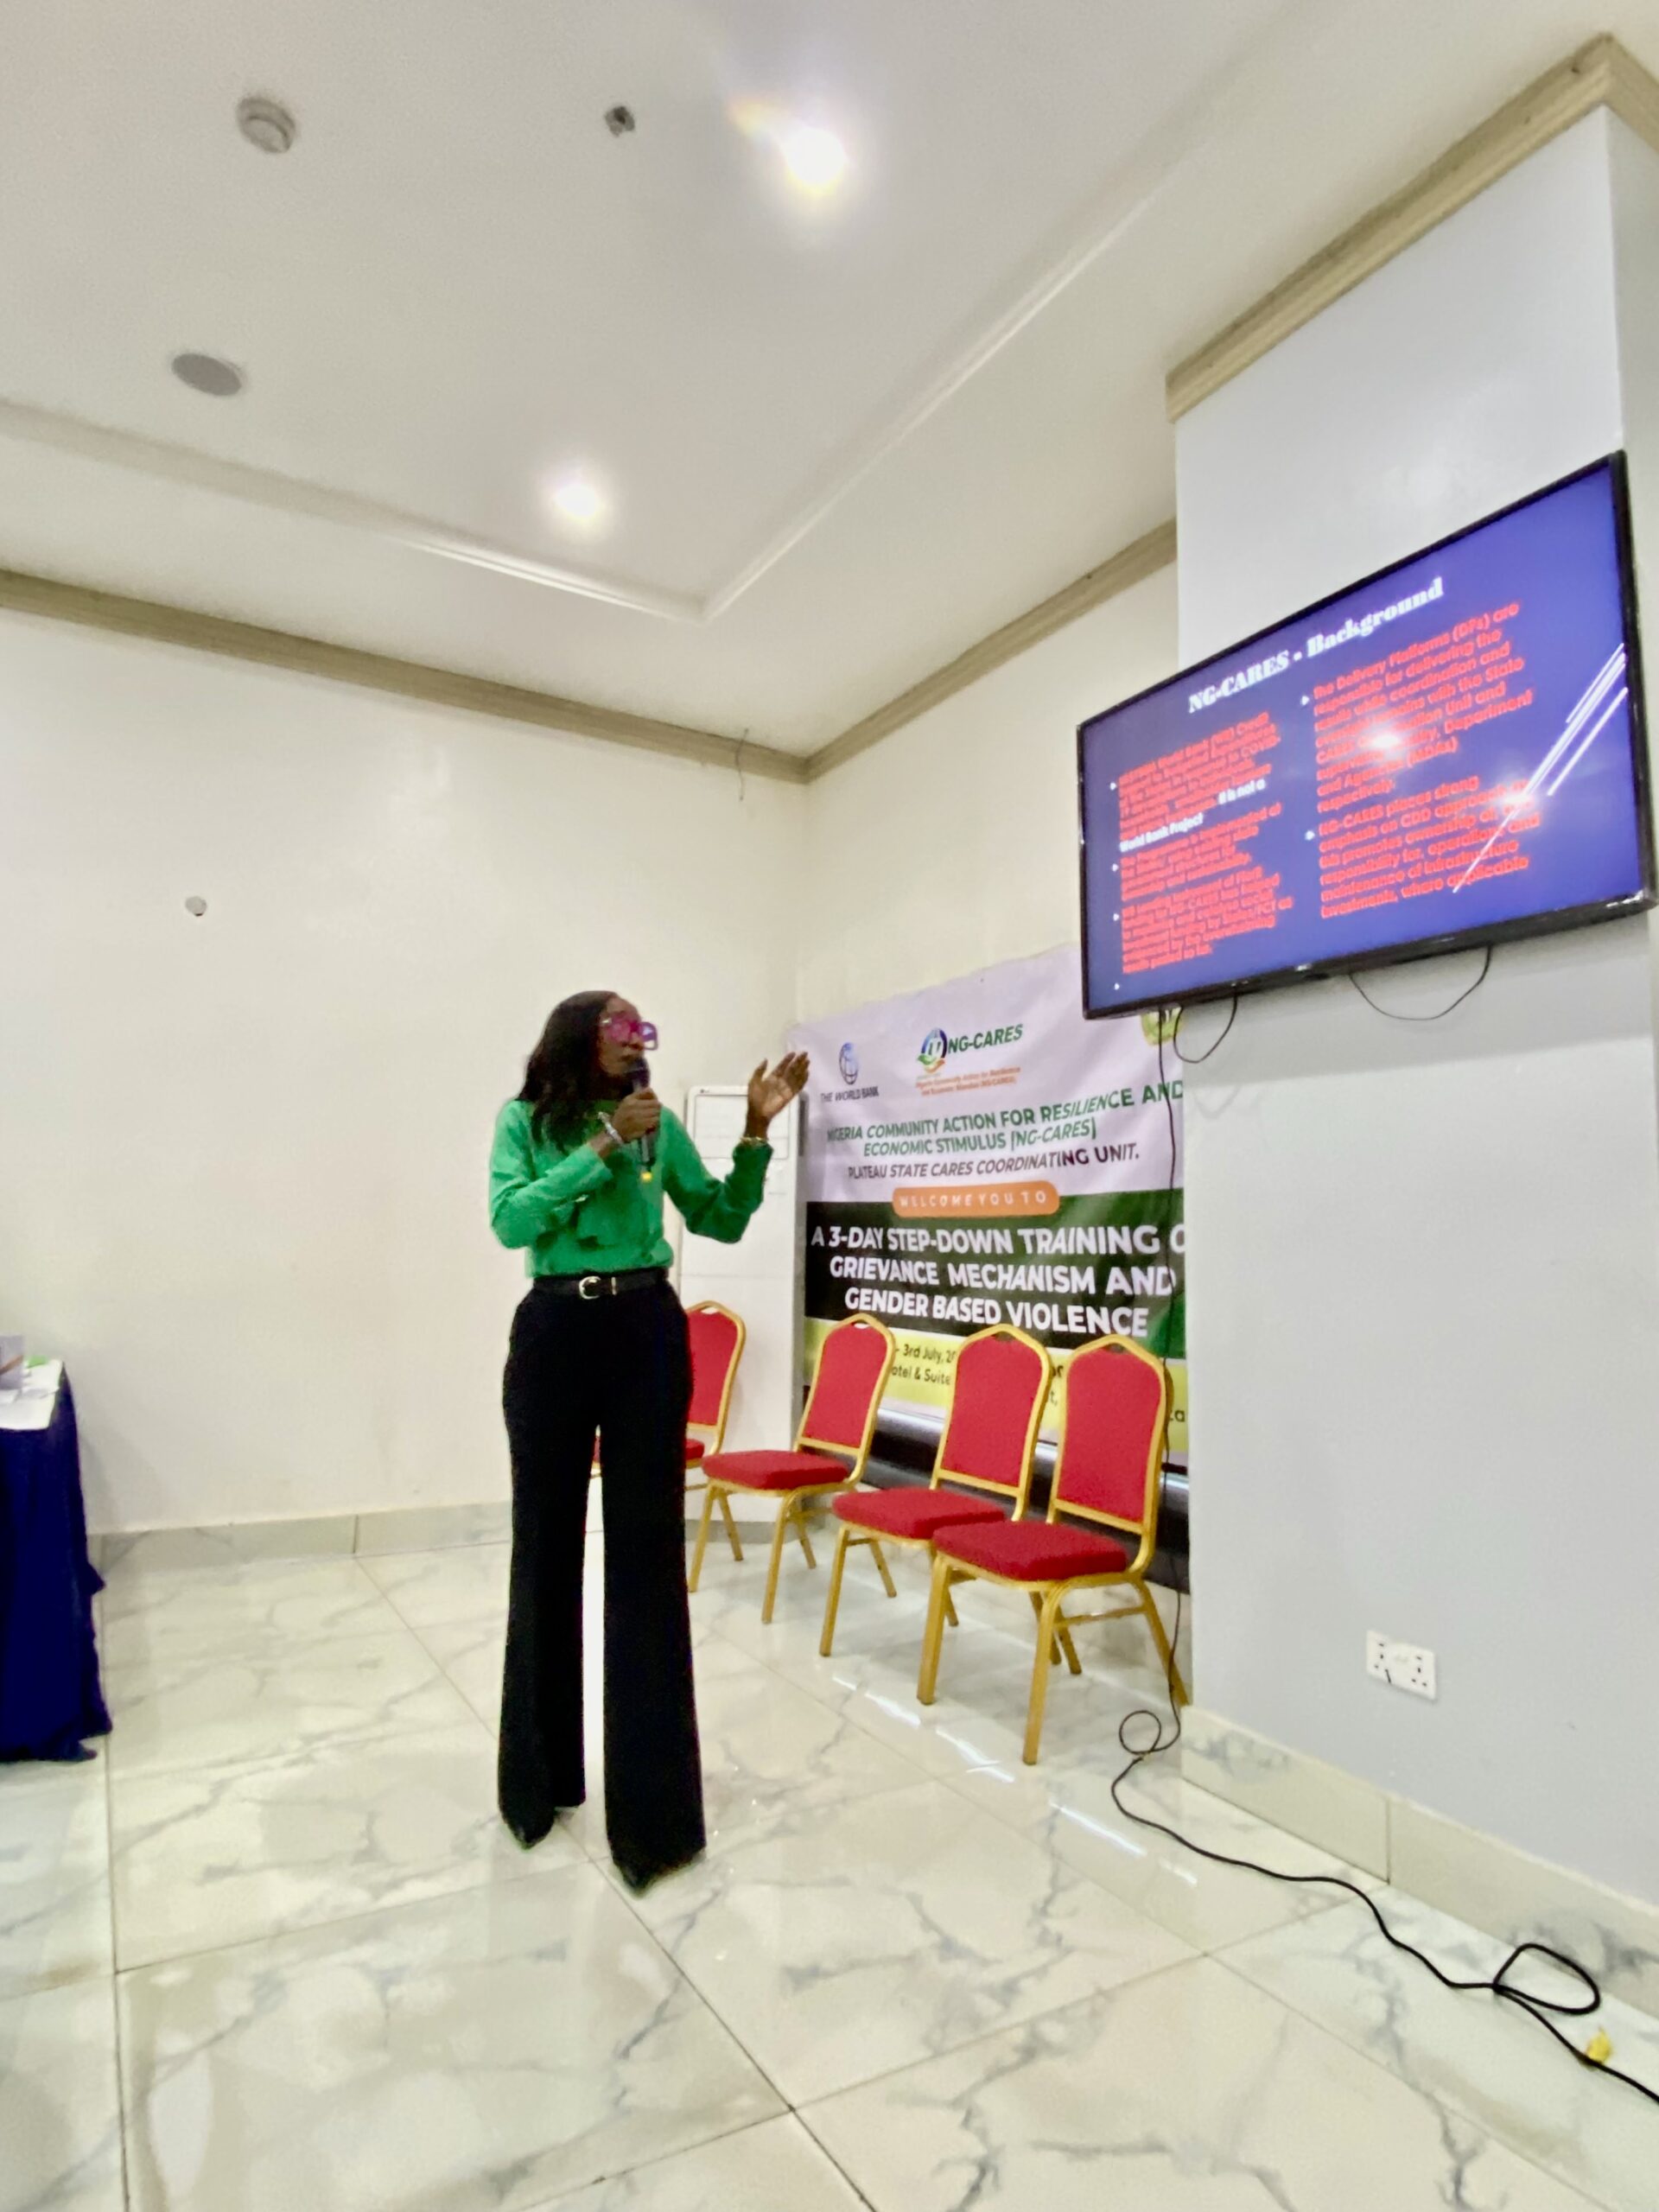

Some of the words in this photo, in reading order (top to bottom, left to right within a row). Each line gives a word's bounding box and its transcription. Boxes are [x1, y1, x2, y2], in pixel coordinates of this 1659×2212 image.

[1188, 650, 1289, 714] NG-CARES
[1306, 576, 1444, 658] Background
[1337, 661, 1386, 690] Delivery
[1389, 632, 1451, 666] Platforms
[1493, 603, 1519, 622] are
[1406, 641, 1474, 677] delivering
[1477, 630, 1502, 647] the
[1390, 658, 1477, 701] coordination
[1480, 641, 1510, 664] and
[1459, 675, 1483, 692] the
[1486, 658, 1524, 682] State
[1475, 681, 1505, 704] and
[1445, 689, 1533, 734] Department
[1317, 778, 1342, 796] and
[1434, 775, 1479, 799] strong
[1381, 820, 1398, 834] on
[1408, 863, 1421, 878] of
[1402, 878, 1443, 898] where
[949, 1023, 1023, 1053] NG-CARES
[821, 1091, 832, 1103] THE
[835, 1089, 861, 1101] WORLD
[862, 1086, 880, 1099] BANK
[827, 1126, 863, 1142] NIGERIA
[867, 1119, 938, 1139] COMMUNITY
[943, 1113, 995, 1133] ACTION
[1001, 1109, 1034, 1126] FOR
[1039, 1088, 1135, 1122] RESILIENCE
[1142, 1080, 1184, 1104] AND
[864, 1139, 933, 1157] ECONOMIC
[937, 1133, 1006, 1154] STIMULUS
[849, 1164, 887, 1179] PLATEAU
[890, 1163, 928, 1178] STATE
[931, 1161, 974, 1176] CARES
[976, 1148, 1089, 1174] COORDINATING
[1094, 1143, 1139, 1163] UNIT.
[899, 1194, 972, 1207] WELCOME
[979, 1192, 1014, 1206] YOU
[1020, 1191, 1047, 1203] TO
[810, 1227, 825, 1247] A
[829, 1226, 883, 1249] 3-DAY
[887, 1228, 1014, 1255] STEP-DOWN
[1017, 1225, 1160, 1255] TRAINING
[830, 1255, 940, 1286] GRIEVANCE
[947, 1262, 1096, 1294] MECHANISM
[1105, 1266, 1176, 1296] AND
[844, 1287, 929, 1317] GENDER
[932, 1295, 1002, 1325] BASED
[1006, 1300, 1149, 1338] VIOLENCE
[903, 1344, 920, 1359] 3rd
[922, 1345, 944, 1365] July,
[891, 1366, 912, 1380] otel
[913, 1367, 921, 1380] &
[923, 1369, 950, 1385] Suite
